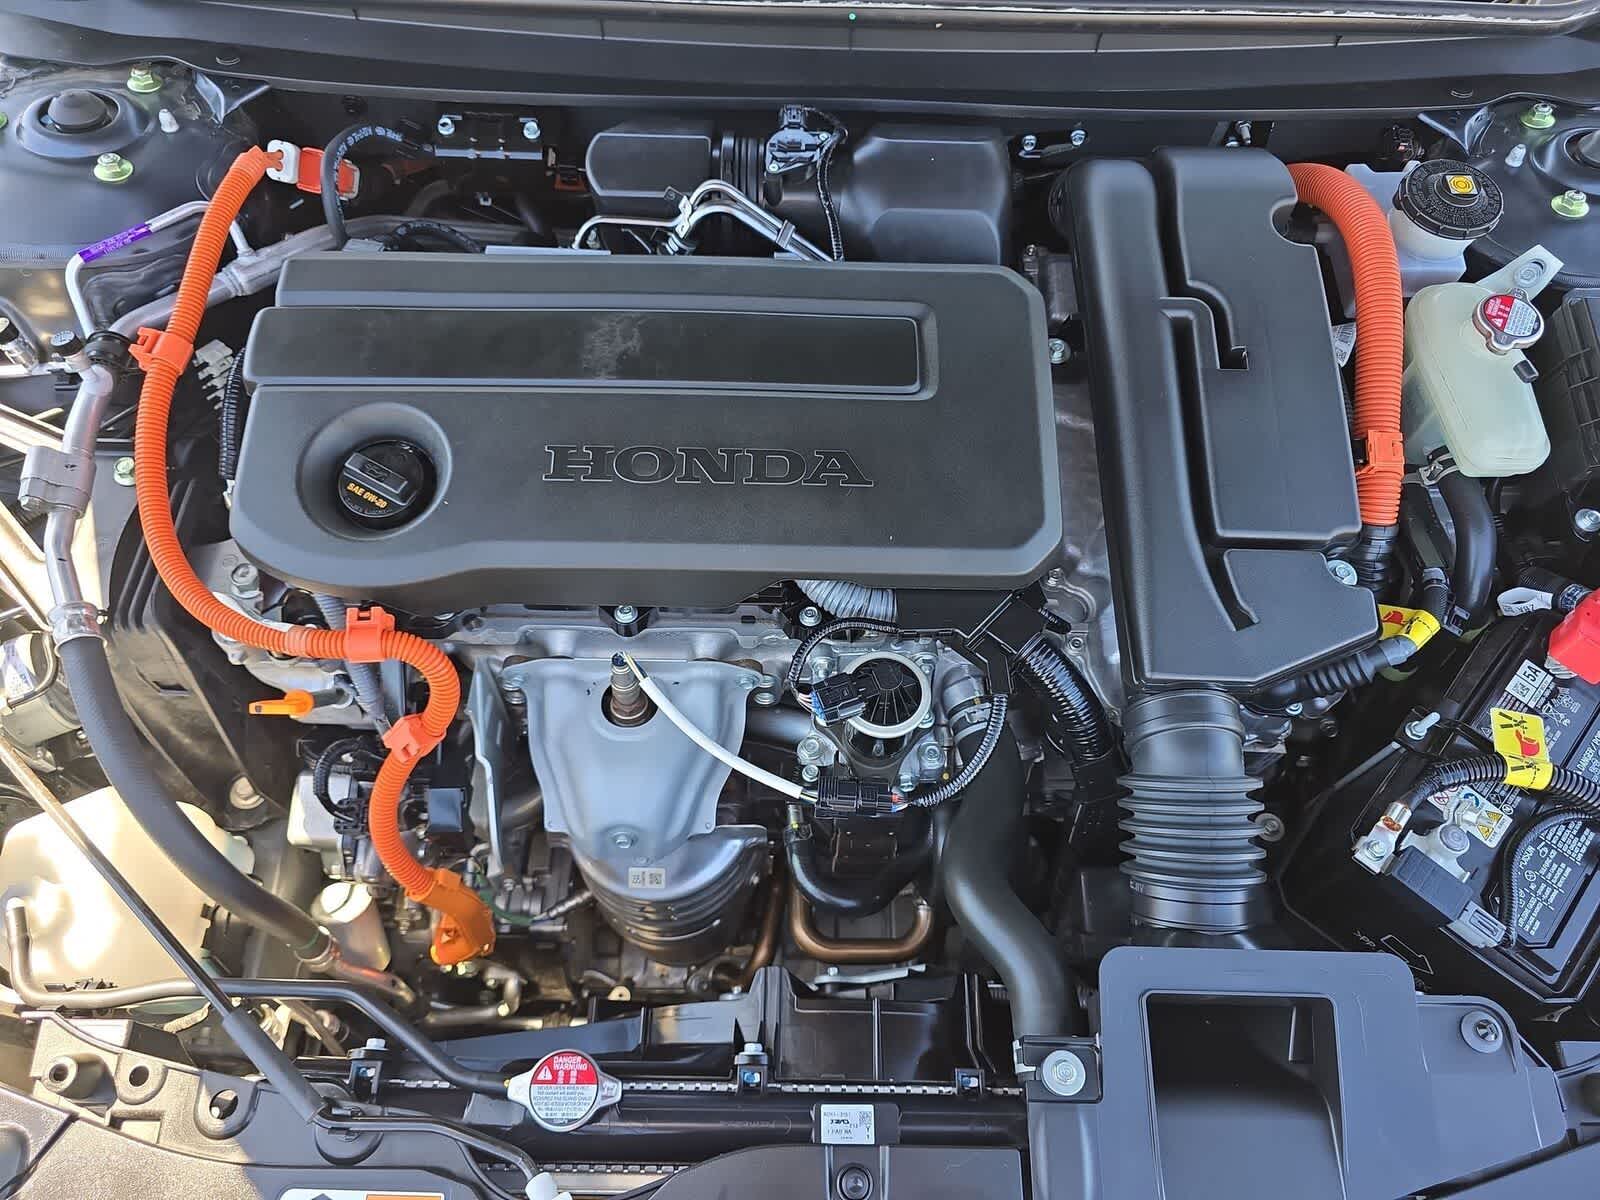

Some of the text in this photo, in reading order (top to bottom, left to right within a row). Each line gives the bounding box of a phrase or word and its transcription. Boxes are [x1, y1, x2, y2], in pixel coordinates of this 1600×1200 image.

[542, 444, 874, 487] HONDA
[346, 482, 365, 496] SAE
[363, 492, 388, 508] 0W-20
[1523, 665, 1541, 682] 5A
